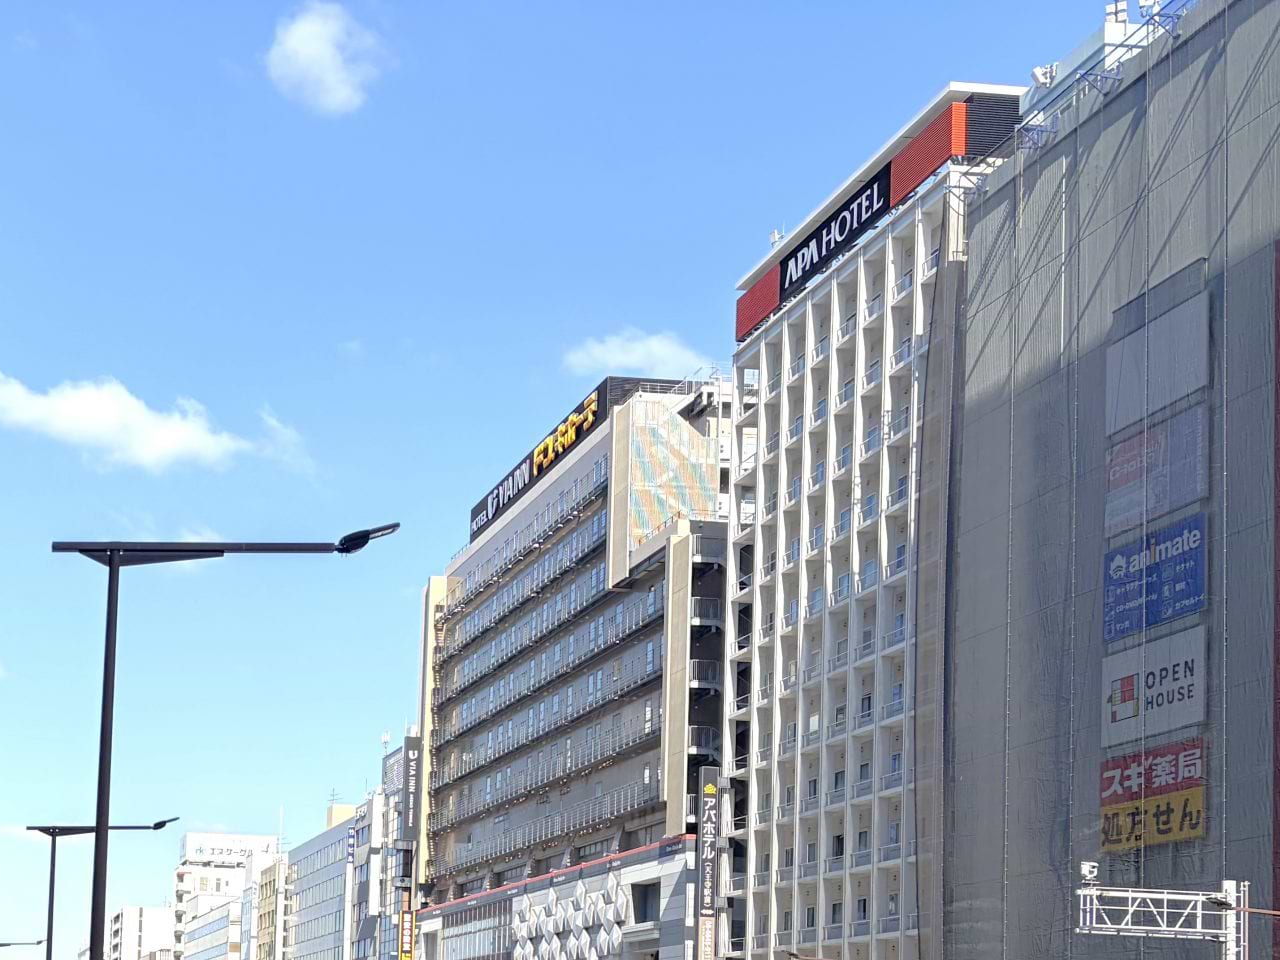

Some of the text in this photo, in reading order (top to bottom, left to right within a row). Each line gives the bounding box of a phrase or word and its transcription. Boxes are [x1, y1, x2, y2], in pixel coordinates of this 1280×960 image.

[821, 181, 885, 257] HOTEL
[784, 240, 819, 289] APA
[1129, 529, 1201, 573] animate
[1145, 683, 1195, 711] HOUSE
[1146, 659, 1195, 690] OPEN
[1102, 748, 1201, 798] スギ薬局
